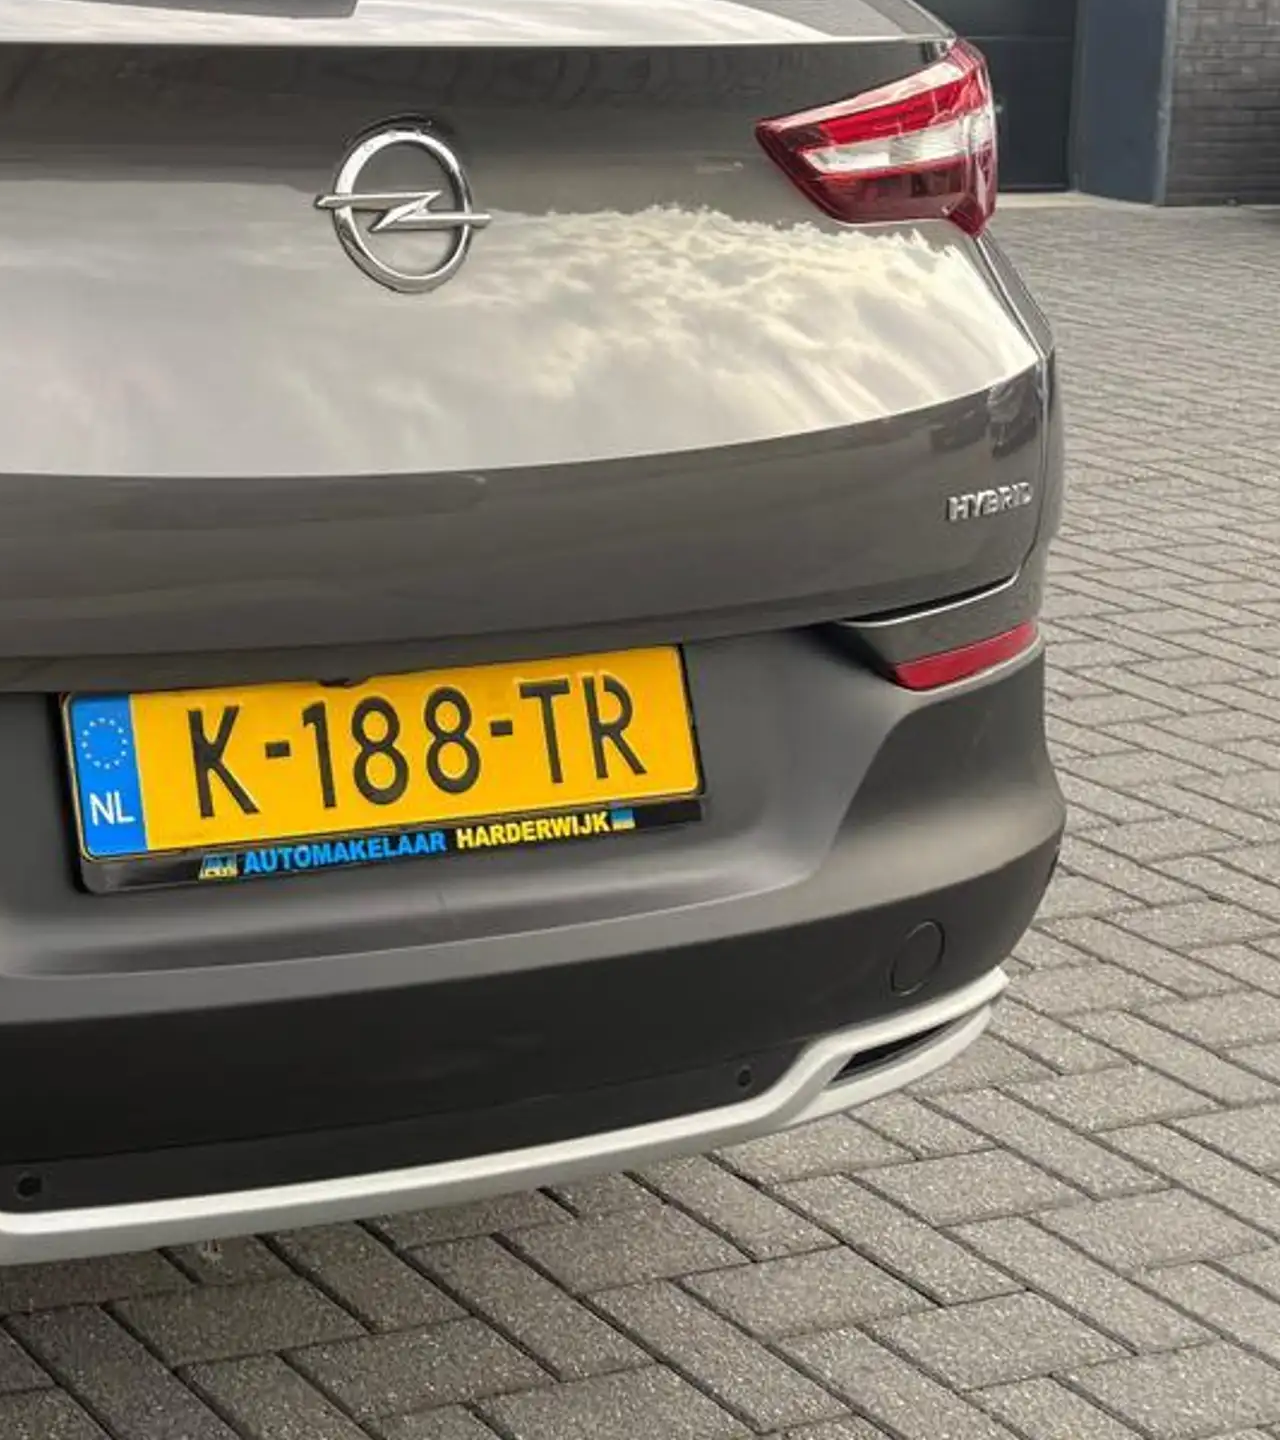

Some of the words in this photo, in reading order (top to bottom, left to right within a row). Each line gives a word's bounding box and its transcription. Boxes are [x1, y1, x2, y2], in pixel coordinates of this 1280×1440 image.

[945, 481, 1034, 522] HYBRID
[185, 671, 649, 822] K-188-TR
[89, 791, 135, 827] NL
[243, 830, 447, 875] AUTOMAKELAAR
[456, 809, 611, 849] HARDERWIJK
